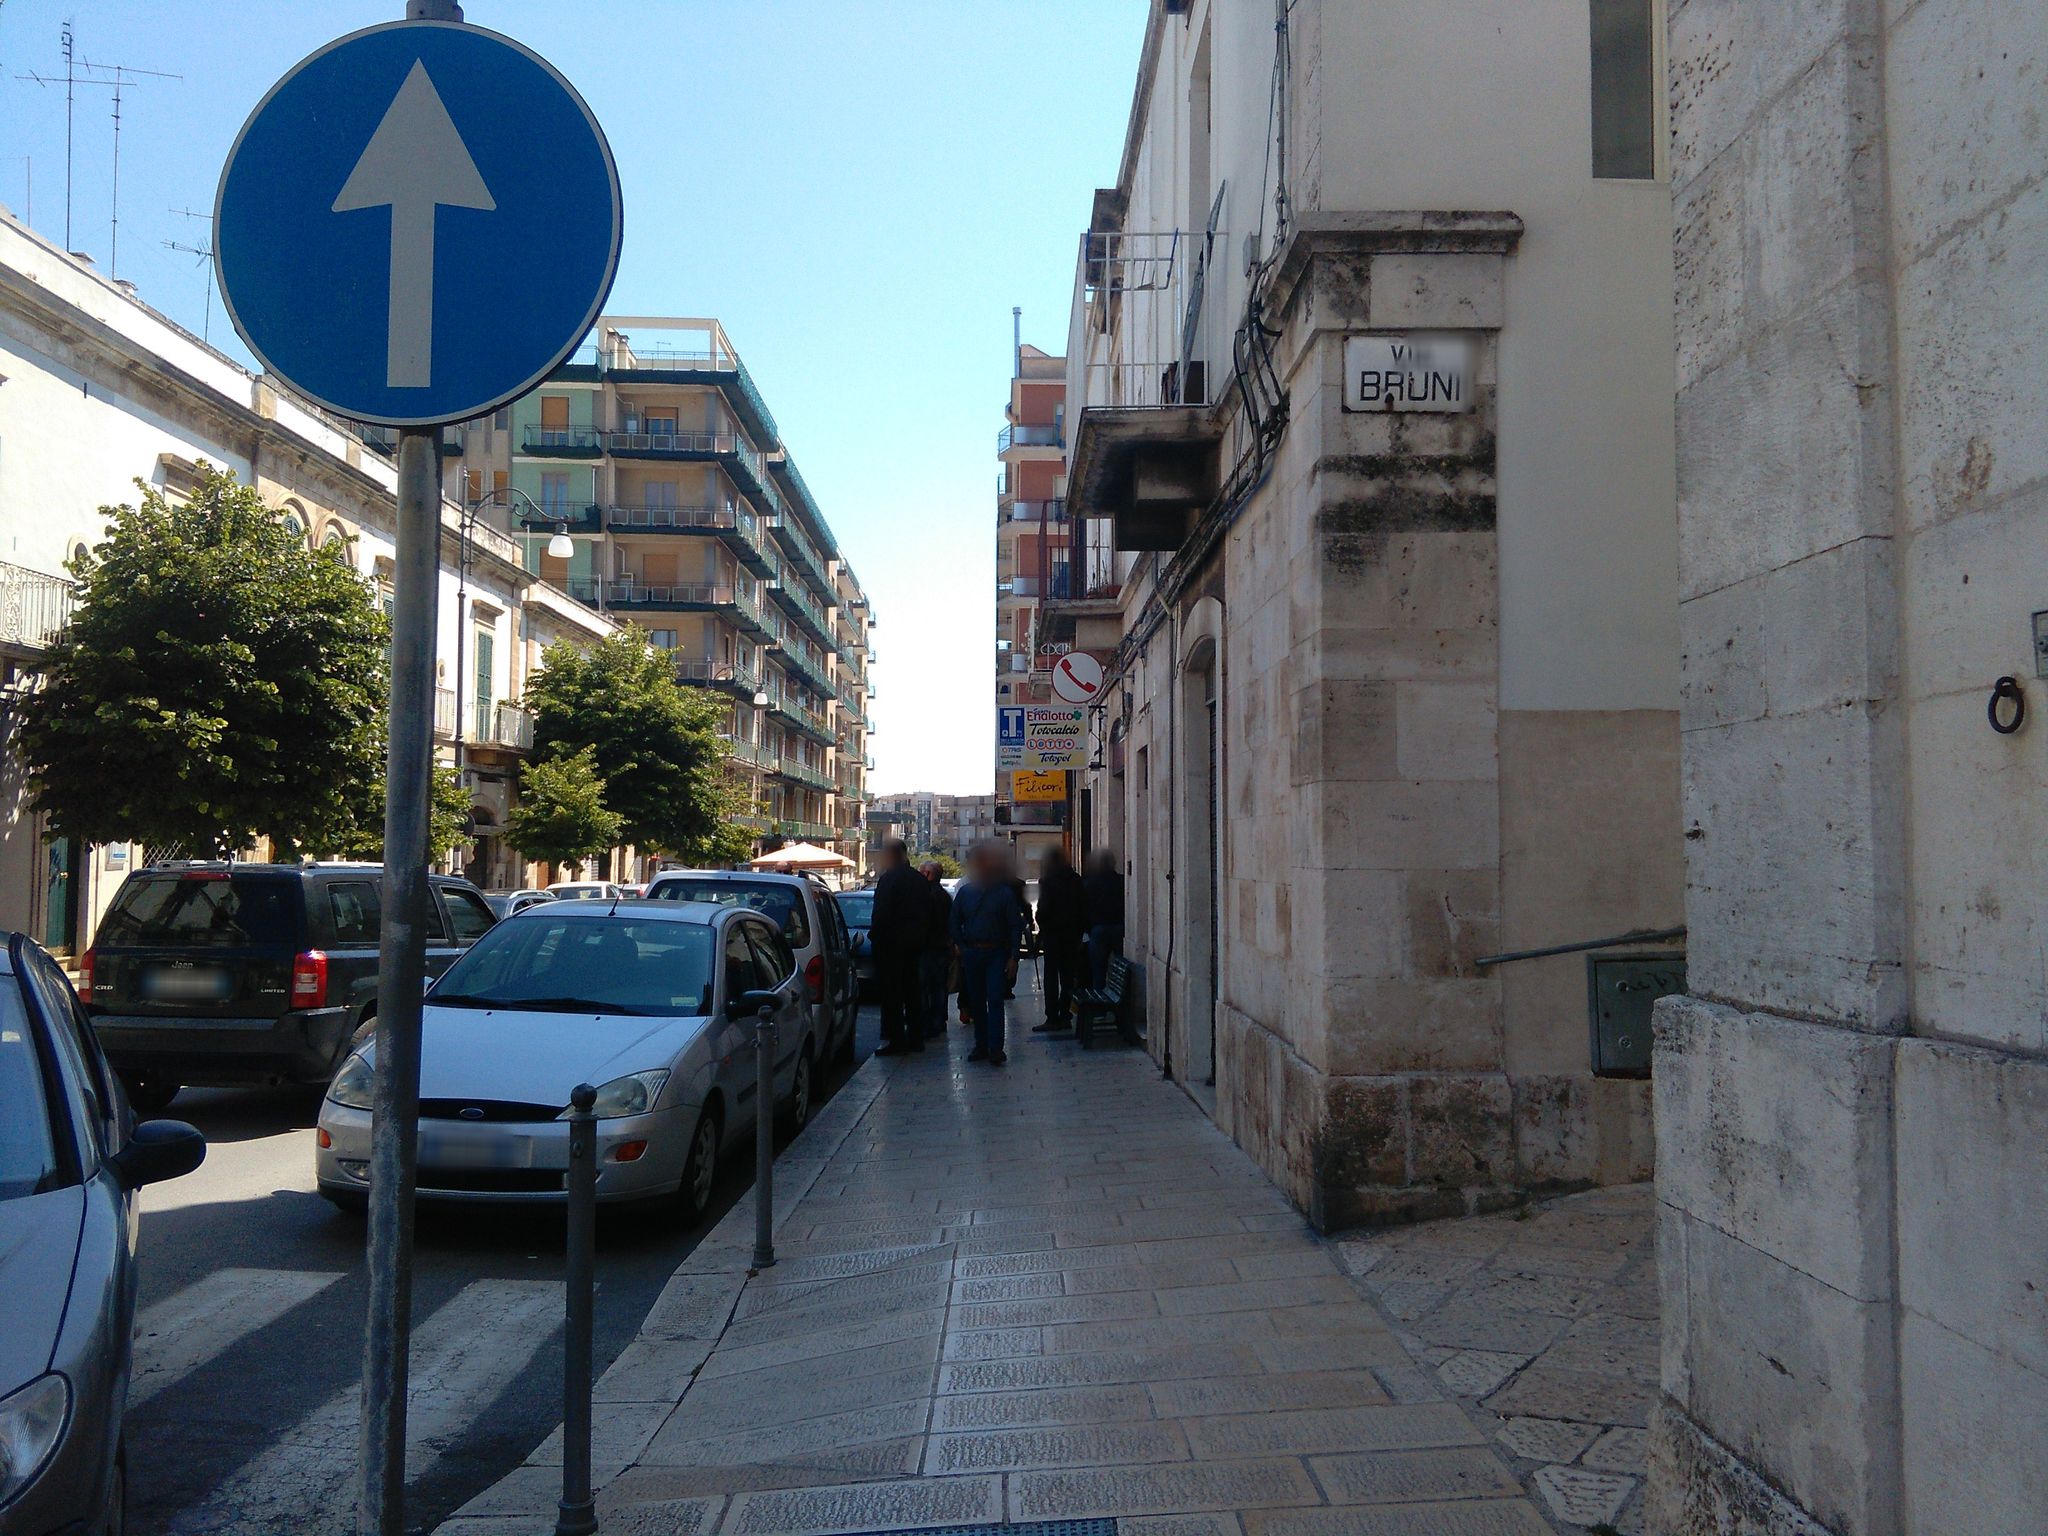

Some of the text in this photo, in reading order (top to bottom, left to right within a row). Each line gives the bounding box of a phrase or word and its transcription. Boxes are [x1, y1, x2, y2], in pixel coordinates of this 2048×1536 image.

[1360, 371, 1460, 401] BRUNI
[1027, 710, 1074, 721] Enalotto
[1029, 723, 1080, 736] Totocalcio
[1027, 739, 1074, 749] LOTTO
[1038, 752, 1072, 766] Totogol
[171, 960, 193, 969] Jeep
